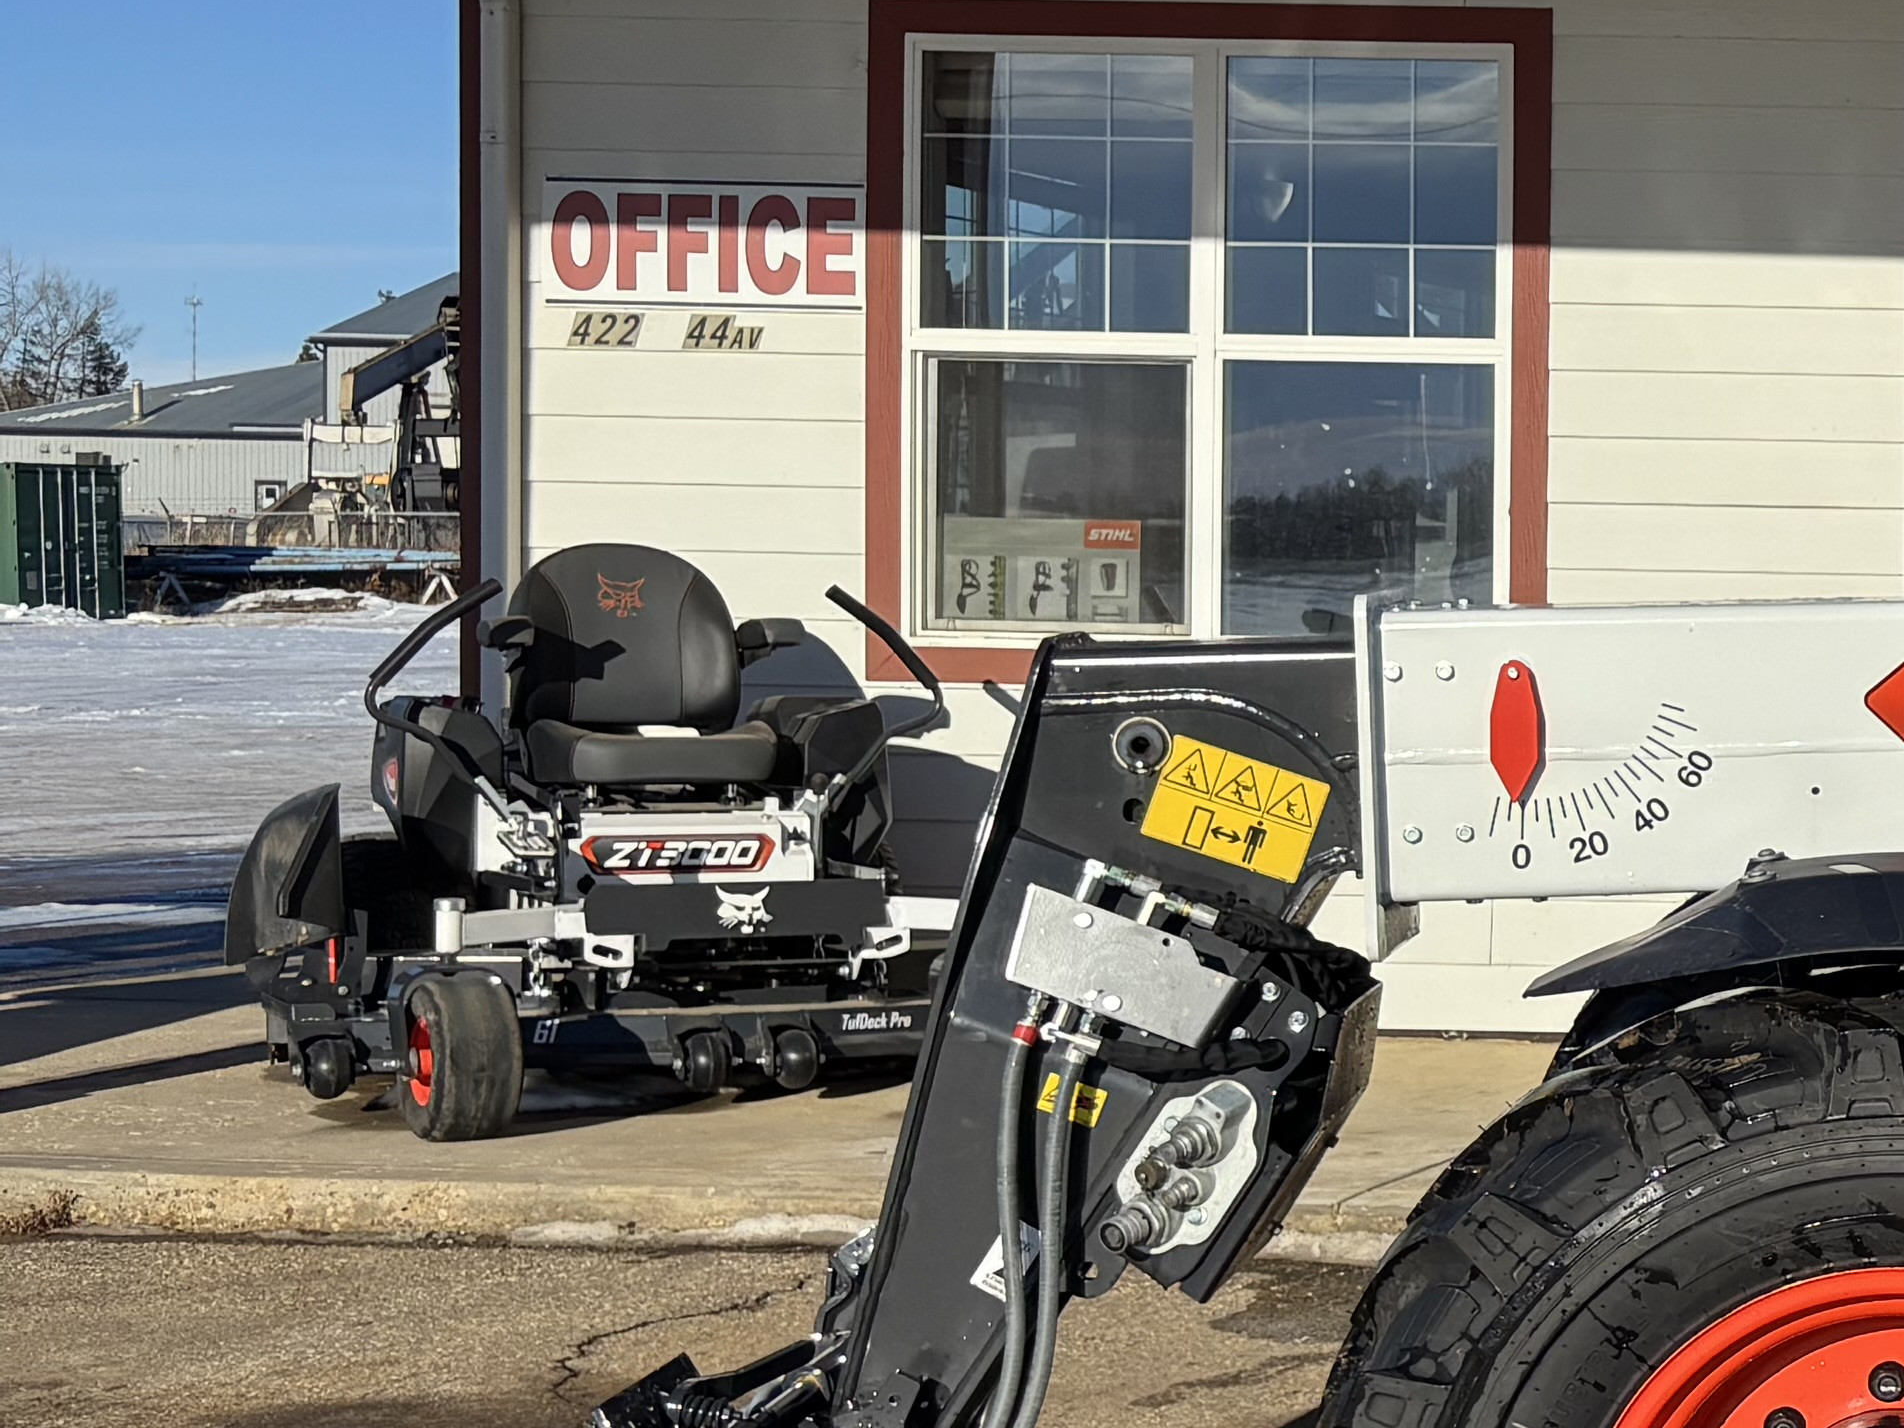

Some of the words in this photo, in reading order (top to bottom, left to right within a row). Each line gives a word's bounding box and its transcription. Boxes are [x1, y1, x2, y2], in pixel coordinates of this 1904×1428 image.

[551, 190, 856, 295] OFFICE
[573, 314, 640, 346] 422
[1088, 528, 1135, 541] STIHL
[1677, 750, 1713, 788] 60
[1633, 797, 1670, 831] 40
[603, 840, 761, 869] ZT3000
[1511, 844, 1531, 869] 0
[1569, 830, 1609, 864] 20
[533, 1019, 560, 1044] 61
[889, 1012, 912, 1029] Pro
